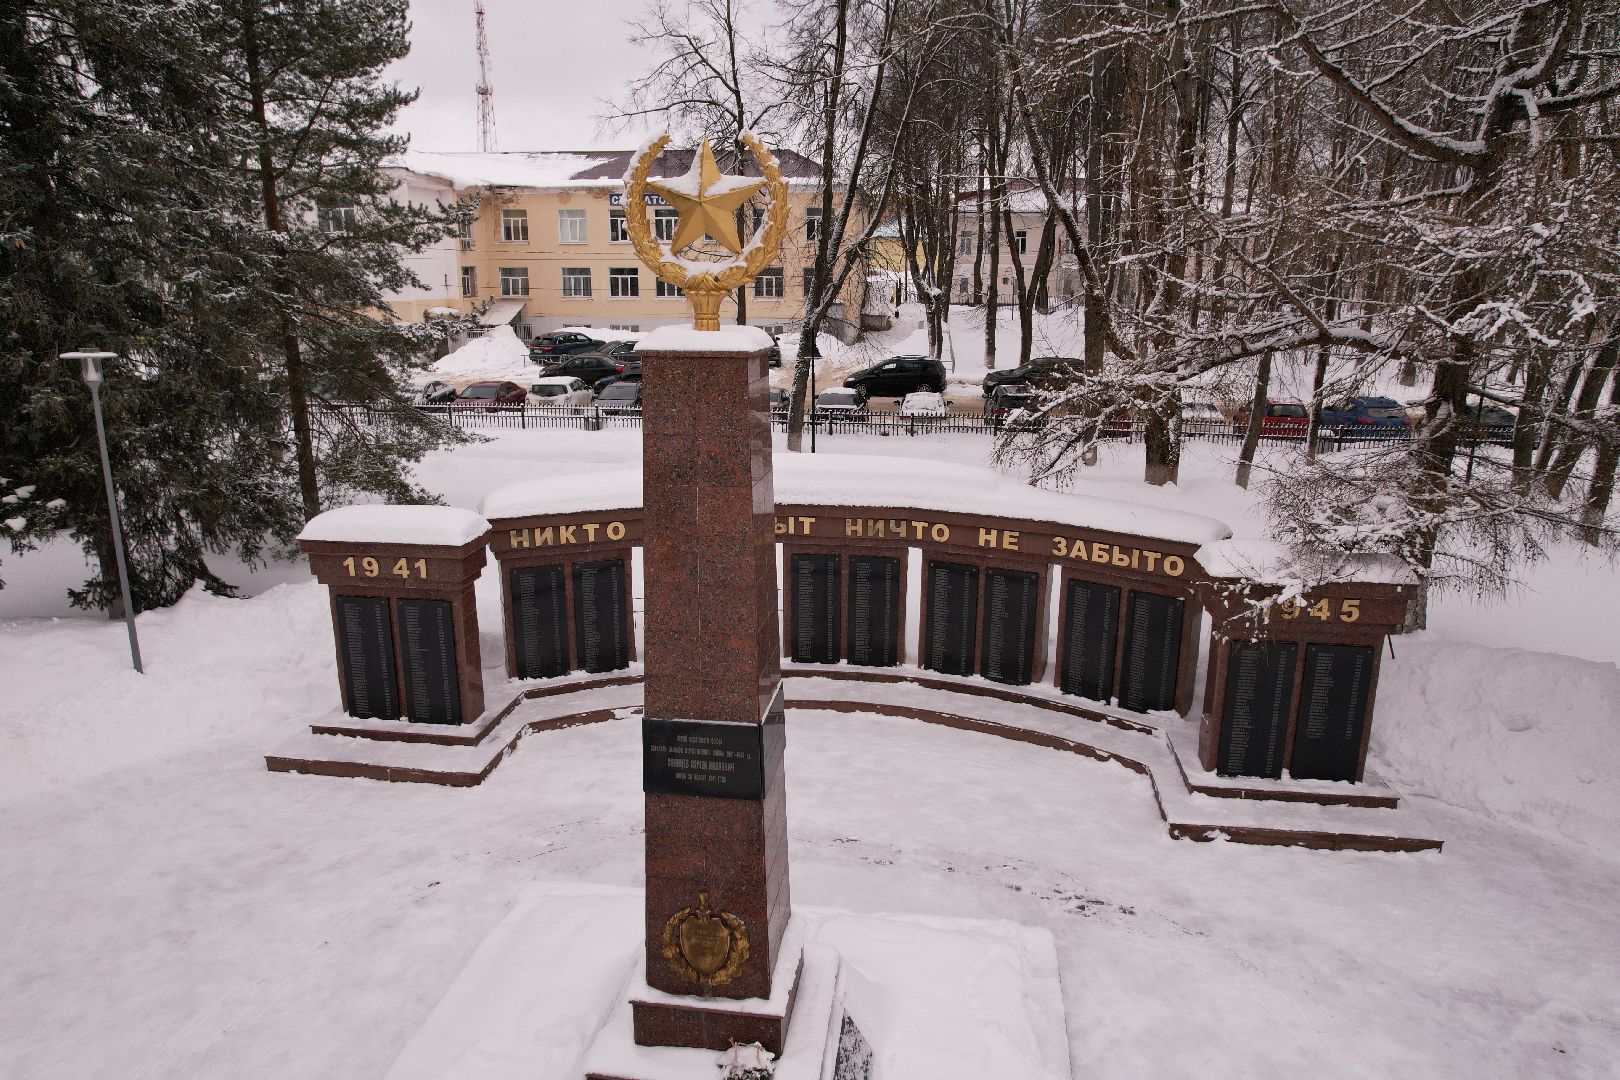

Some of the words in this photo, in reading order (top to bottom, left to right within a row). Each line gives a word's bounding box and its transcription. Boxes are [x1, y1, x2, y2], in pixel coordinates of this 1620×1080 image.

[510, 521, 626, 549] НИКТО
[845, 518, 950, 542] НИЧТО
[978, 527, 1020, 551] НЕ
[1052, 536, 1185, 577] ЗАБЫТО
